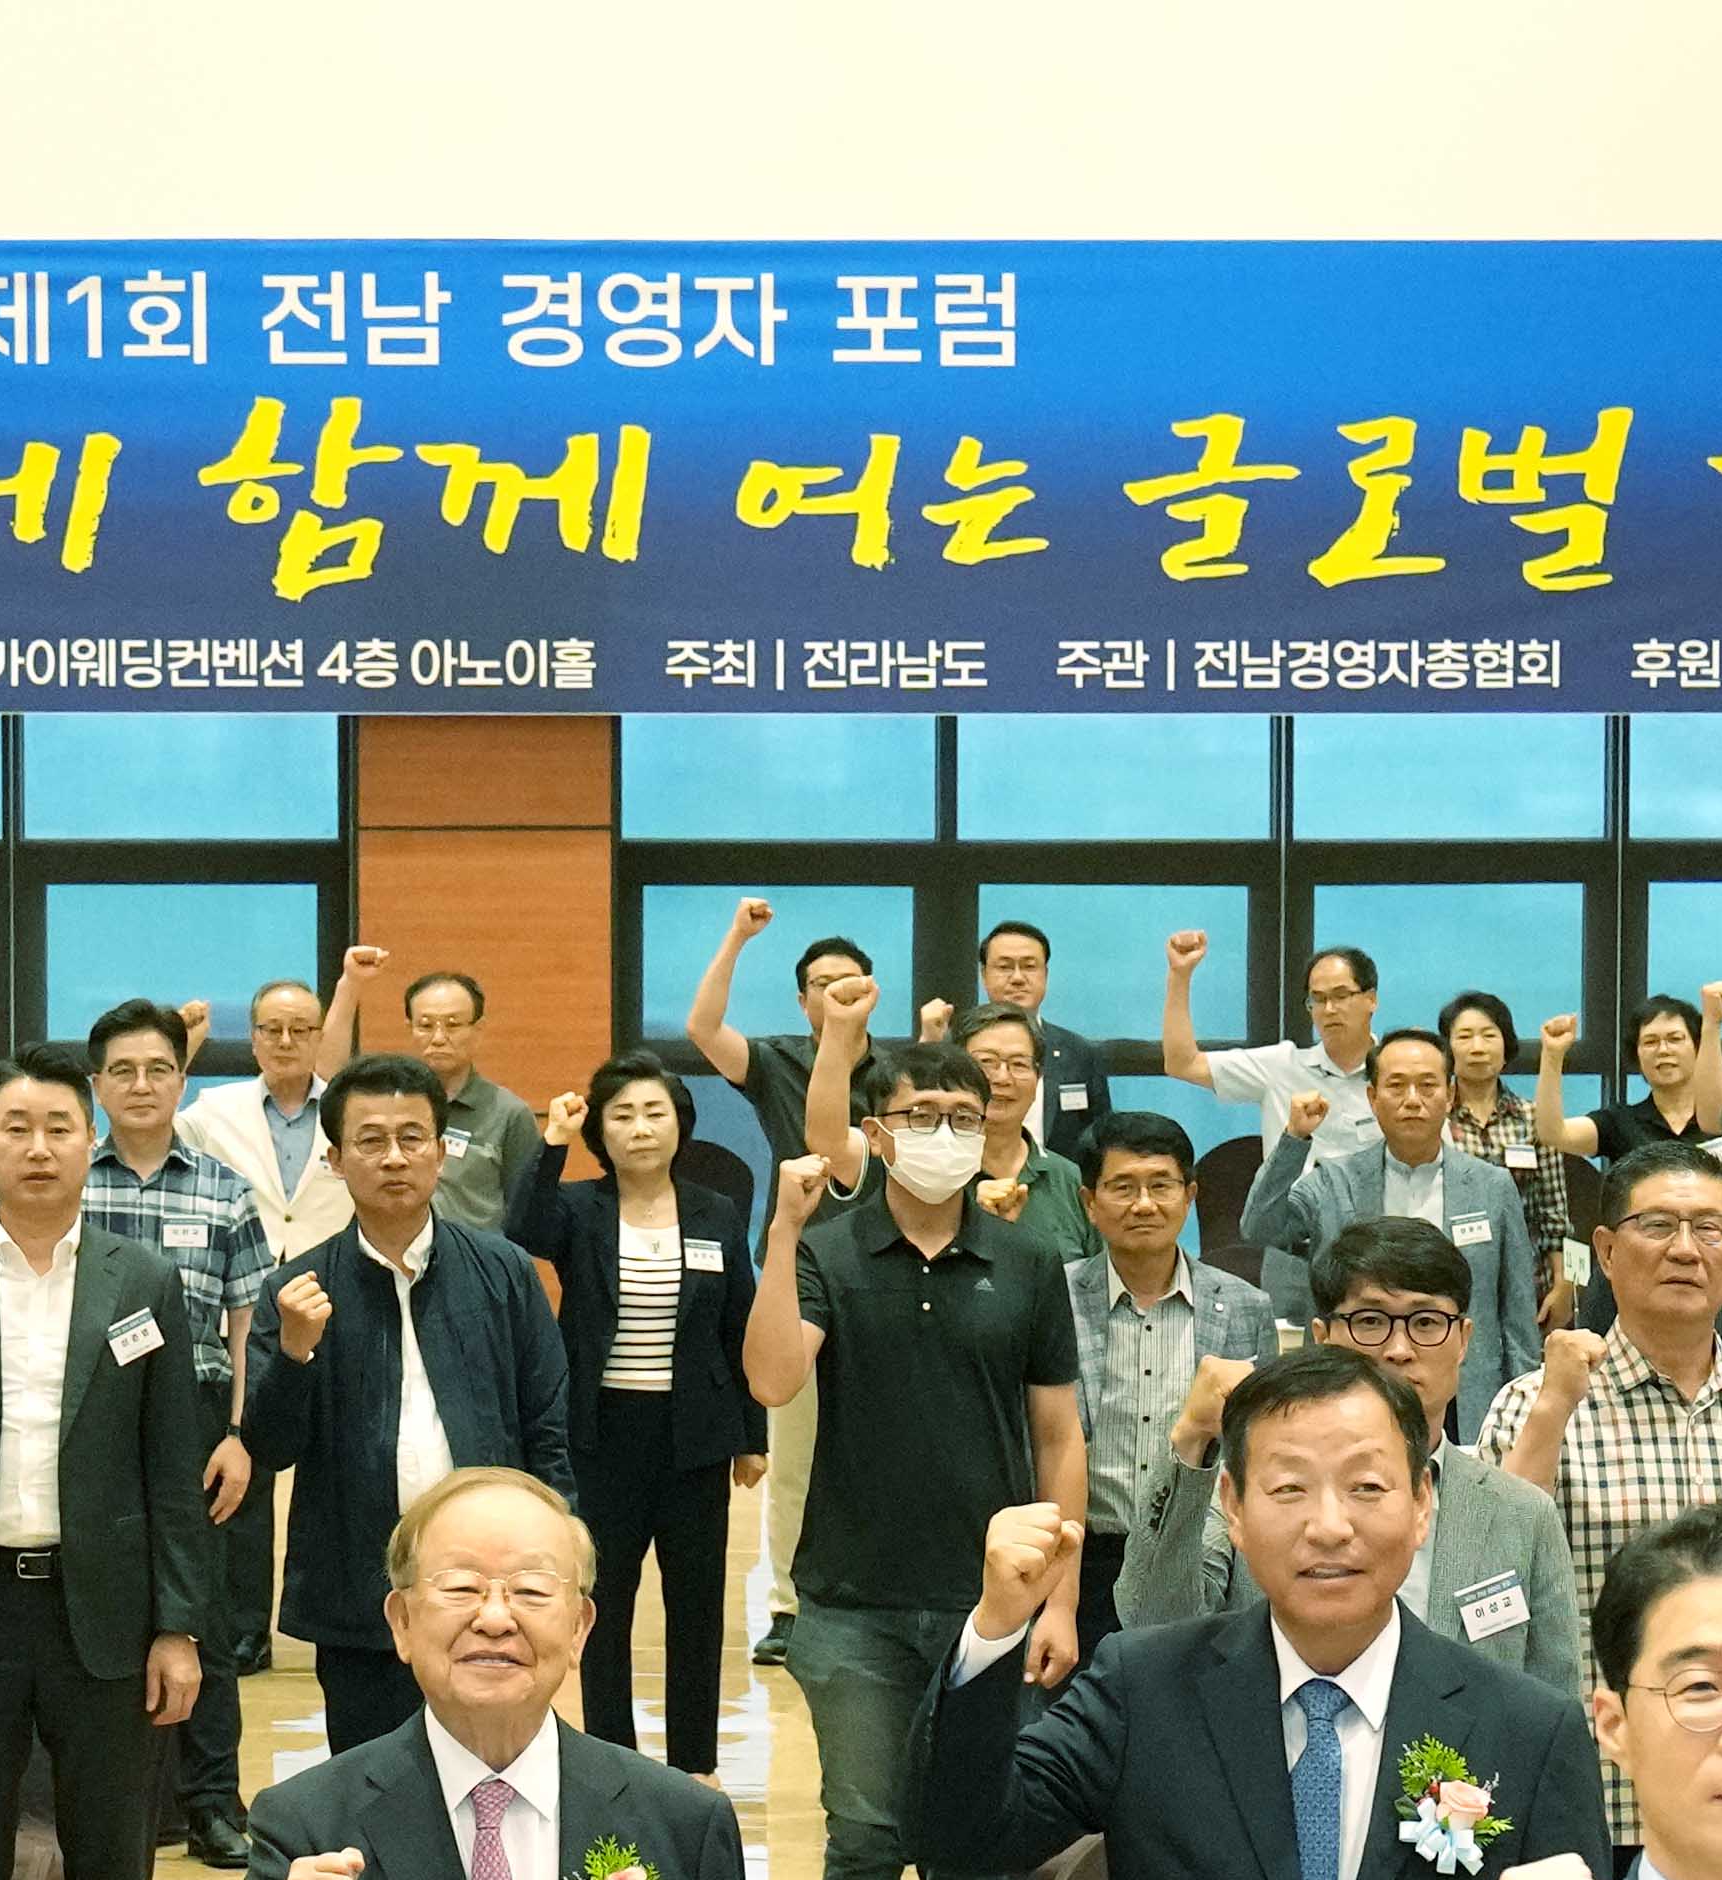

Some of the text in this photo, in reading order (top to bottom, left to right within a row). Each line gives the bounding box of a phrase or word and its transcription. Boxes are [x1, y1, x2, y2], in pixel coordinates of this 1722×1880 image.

[263, 272, 453, 367] 전남
[503, 272, 789, 369] 경영자
[833, 273, 1017, 368] 포럼
[199, 398, 651, 603] 함께
[737, 437, 1046, 568] 여는
[1126, 407, 1634, 592] 글로벌
[317, 639, 400, 689] 4층
[411, 638, 598, 690] 아노이홀
[666, 640, 757, 689] 주최
[804, 640, 989, 690] 전라남도
[1057, 640, 1151, 690] 주관
[1195, 639, 1562, 691] 전남경영자총협회
[1632, 639, 1722, 689] 후원
